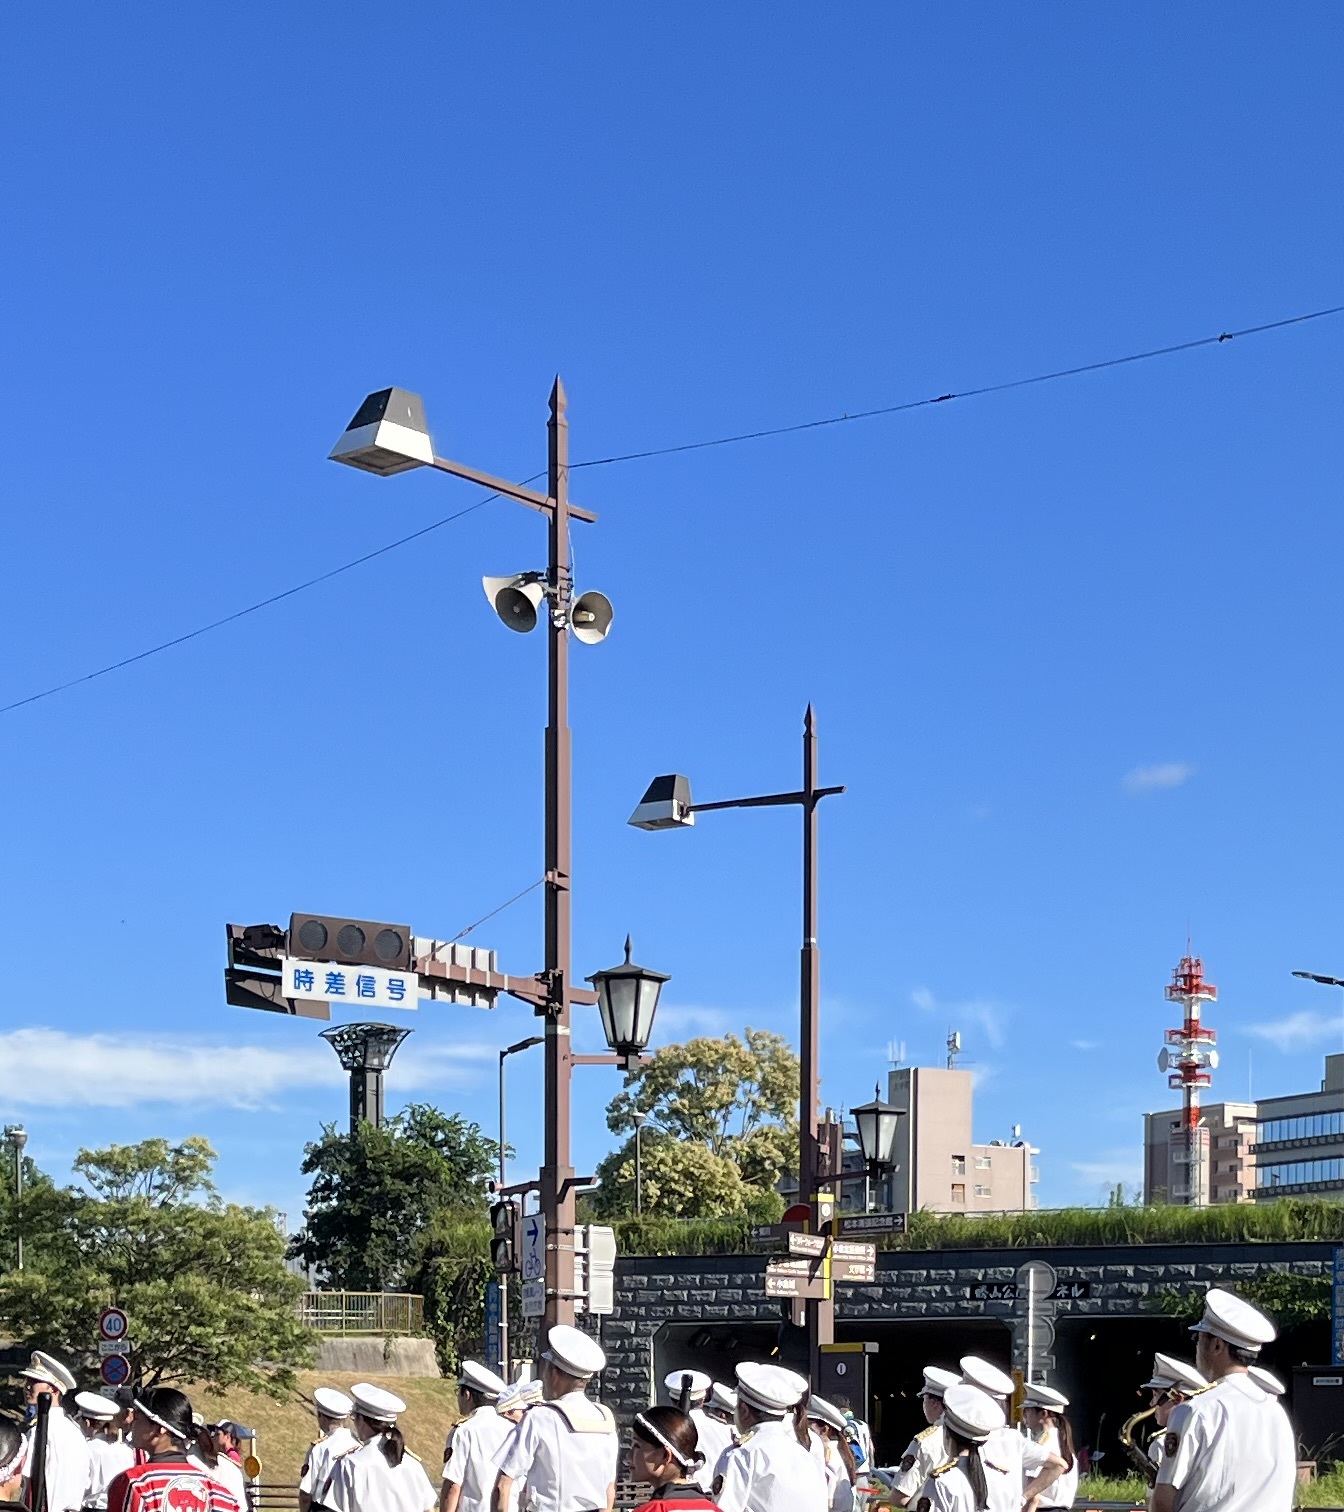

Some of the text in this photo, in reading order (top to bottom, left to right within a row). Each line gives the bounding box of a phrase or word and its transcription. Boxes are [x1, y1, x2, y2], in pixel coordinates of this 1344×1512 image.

[293, 968, 407, 1002] 時差信号
[105, 1317, 122, 1332] 40
